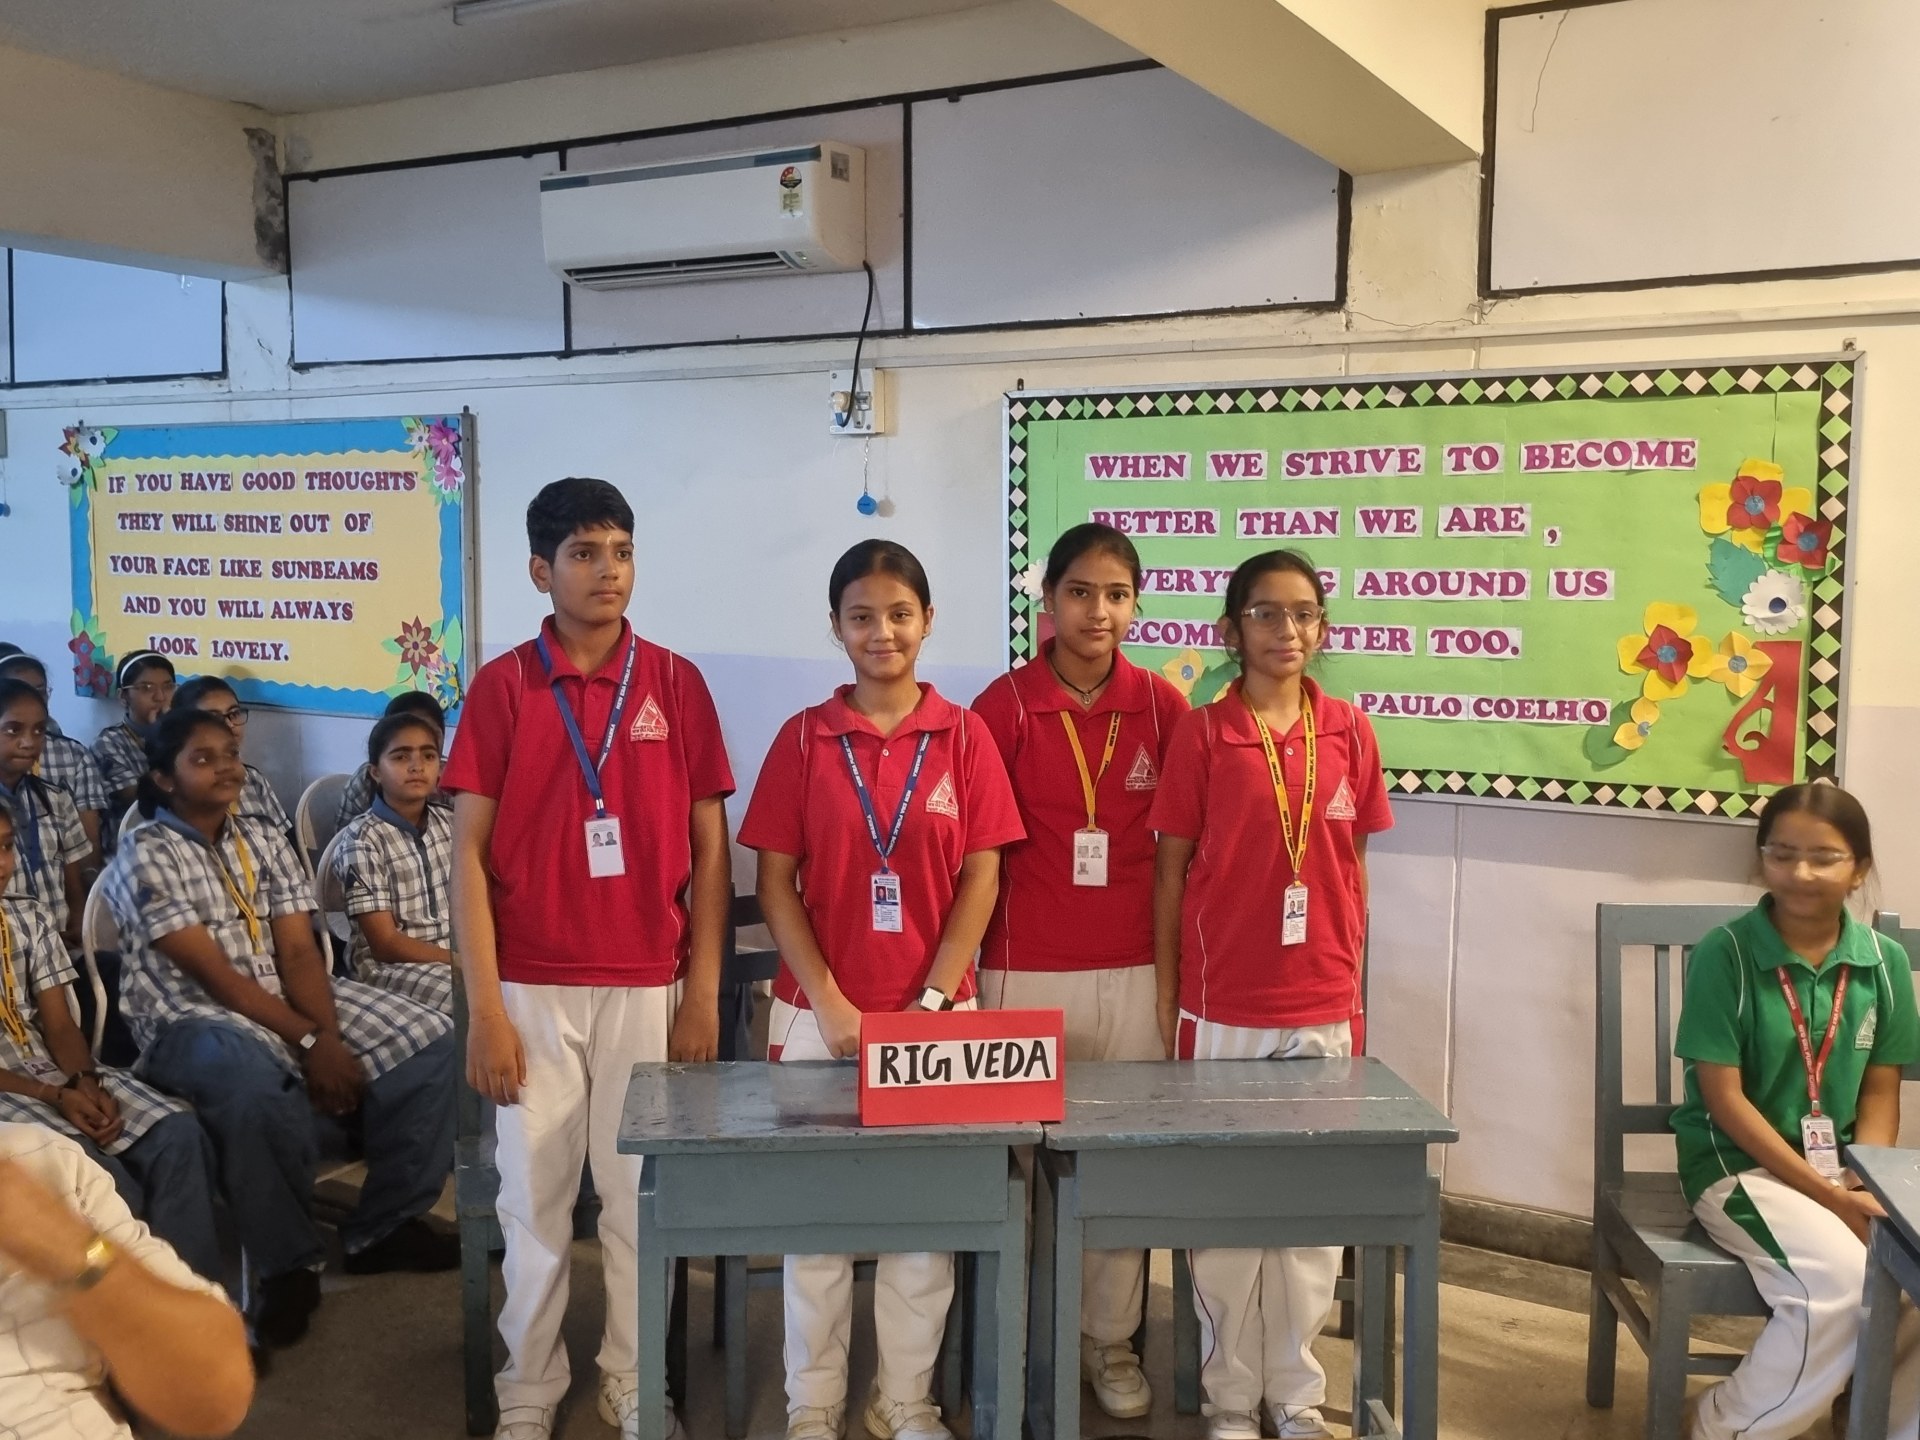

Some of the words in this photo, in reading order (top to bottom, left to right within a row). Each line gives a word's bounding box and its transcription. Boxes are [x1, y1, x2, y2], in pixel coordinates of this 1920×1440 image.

[1089, 454, 1187, 479] WHEN
[1209, 452, 1263, 477] WE
[1285, 448, 1421, 476] STRIVE
[1447, 446, 1500, 472] TO
[1524, 440, 1697, 470] BECOME
[108, 475, 126, 494] IF
[135, 473, 173, 492] YOU
[180, 472, 232, 492] HAVE
[242, 471, 296, 491] GOOD
[304, 471, 419, 491] THOUGHTS
[117, 512, 164, 531] THEY
[171, 513, 217, 532] WILL
[223, 513, 282, 534] SHINE
[289, 513, 330, 533] OUT
[344, 512, 373, 533] OF
[1239, 510, 1339, 536] THAN
[1359, 508, 1417, 533] WE
[1443, 506, 1526, 533] ARE
[109, 555, 158, 575] YOUR
[163, 557, 211, 576] FACE
[219, 558, 262, 578] LIKE
[271, 560, 380, 581] SUNBEAMS
[1357, 570, 1528, 597] AROUND
[1553, 571, 1609, 598] US
[123, 595, 161, 614] AND
[167, 598, 207, 617] YOU
[217, 600, 264, 619] WILL
[270, 600, 354, 621] ALWAYS
[148, 636, 199, 656] LOOK
[211, 640, 290, 662] LOVELY.
[1431, 628, 1520, 656] TOO.
[1360, 693, 1464, 717] PAULO
[1472, 697, 1608, 724] COELHO
[879, 1043, 952, 1086] RIG
[962, 1039, 1052, 1081] VEDA
